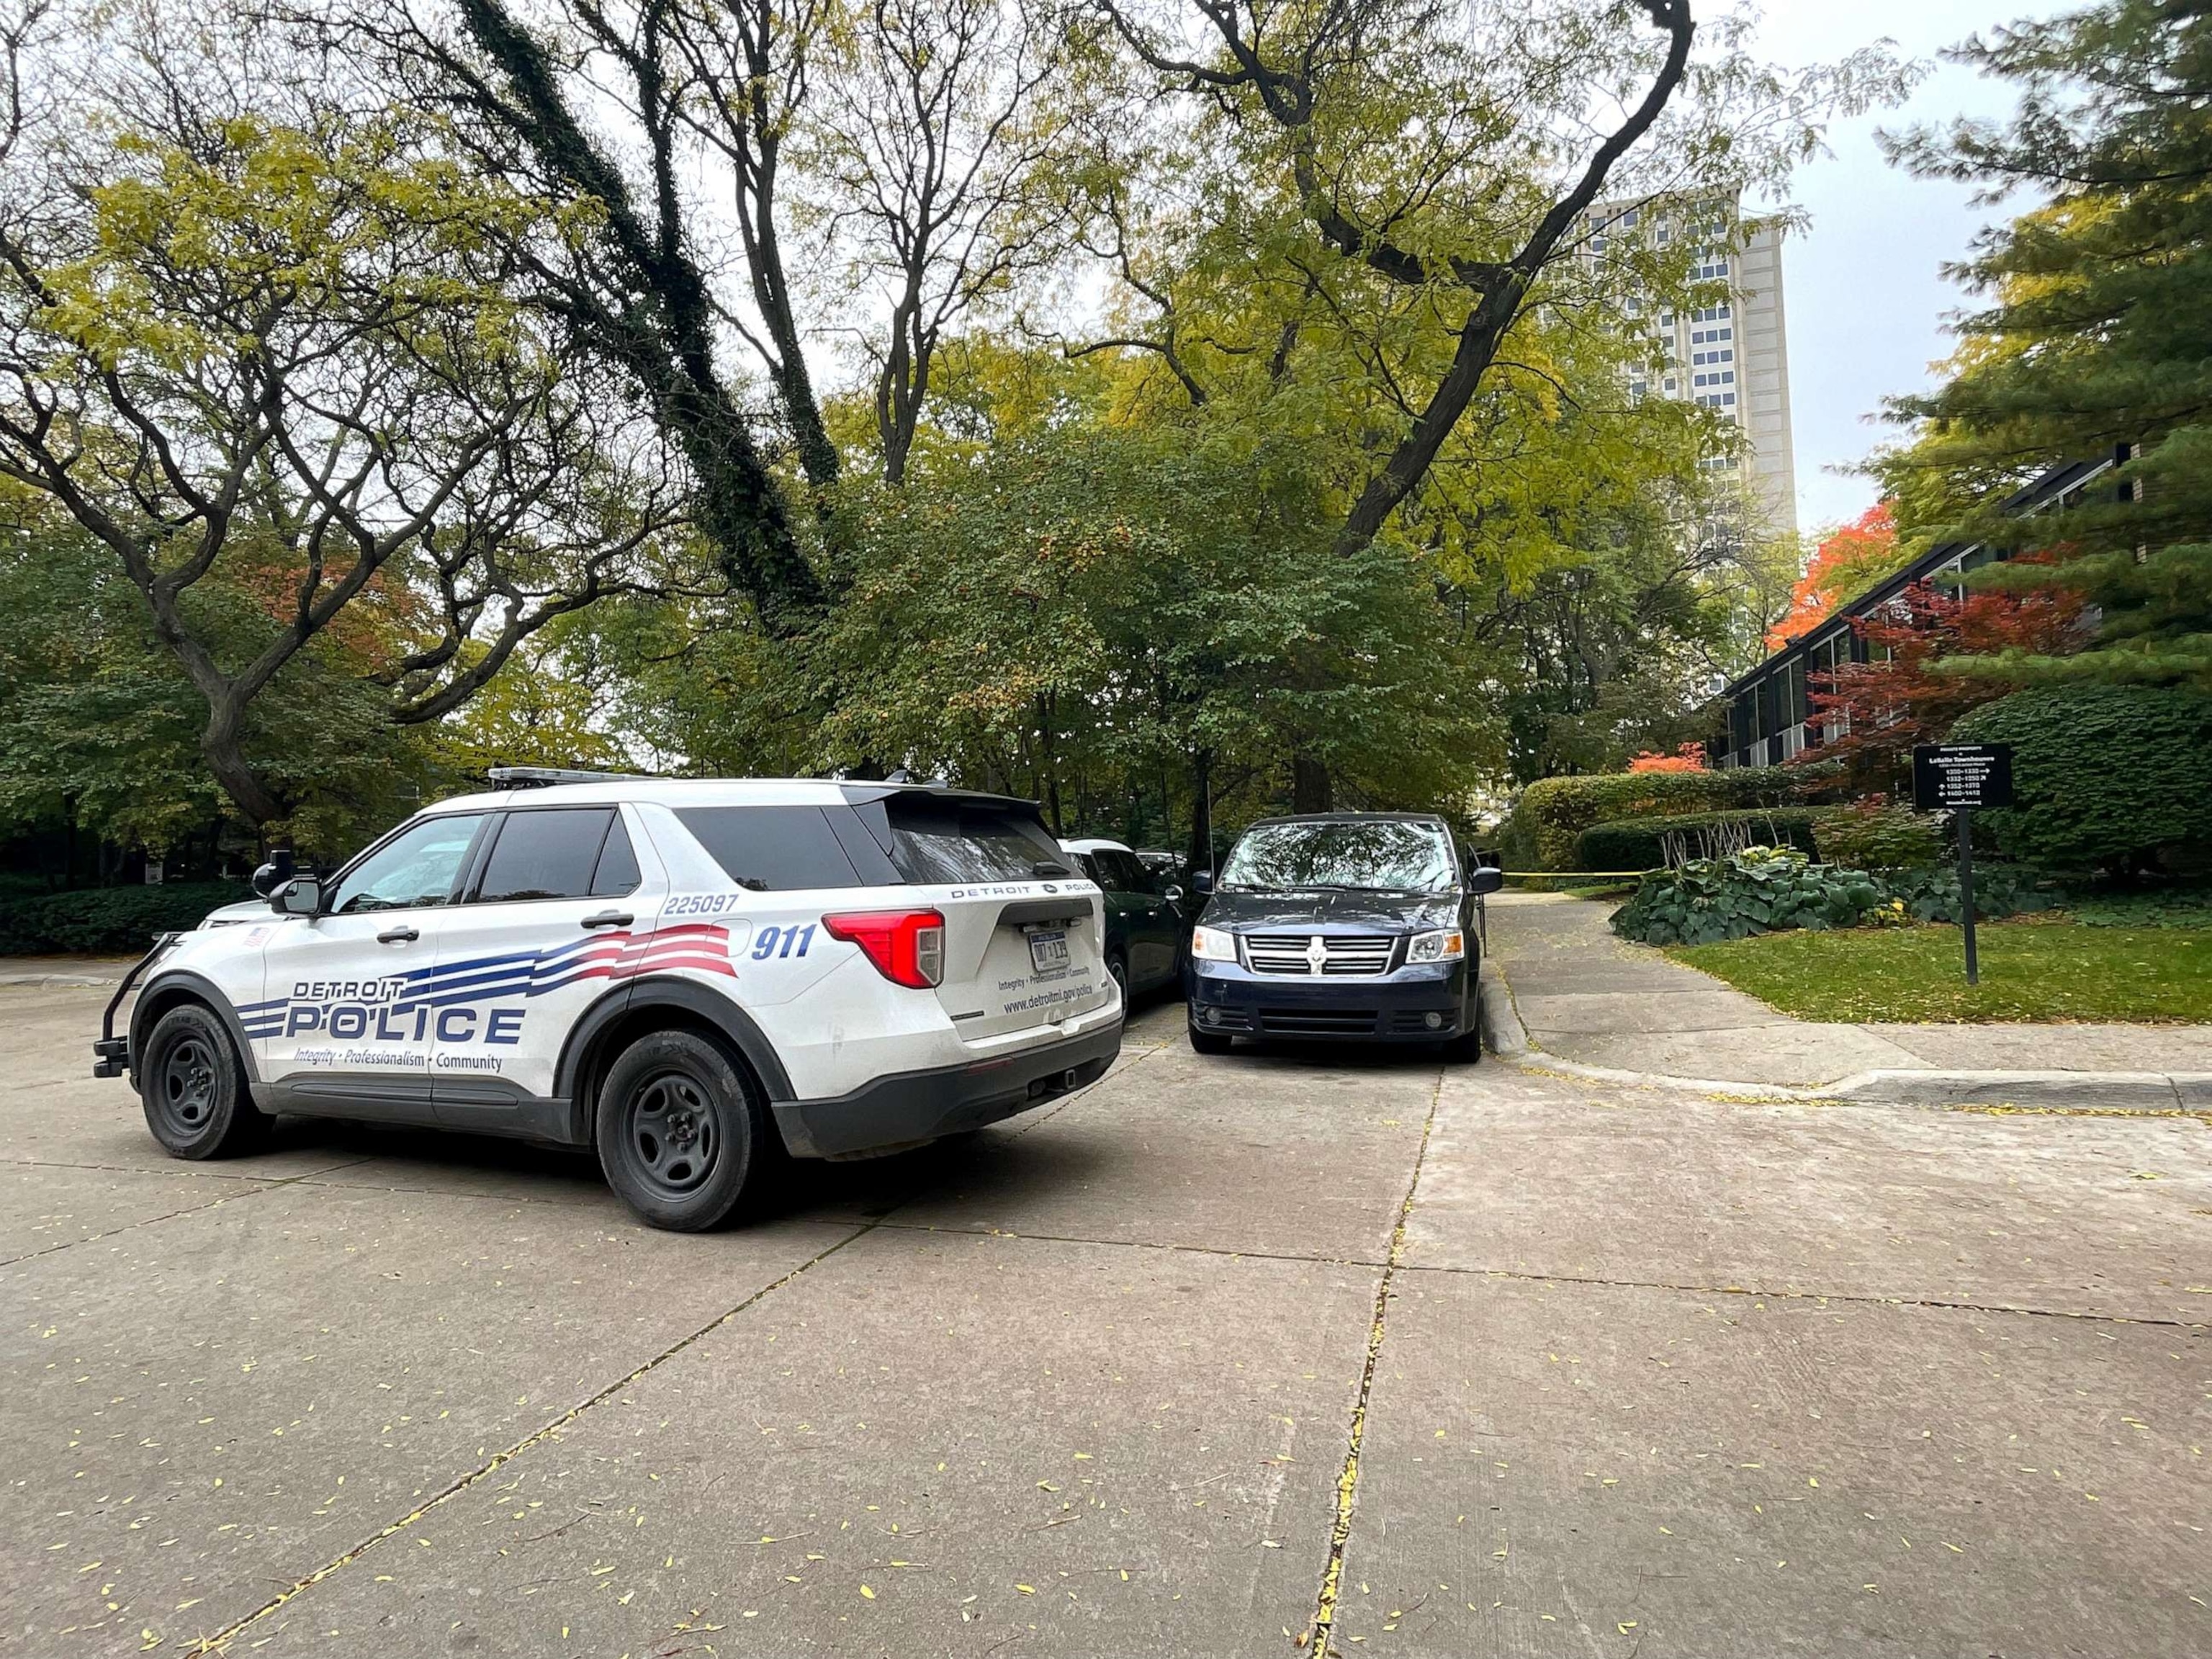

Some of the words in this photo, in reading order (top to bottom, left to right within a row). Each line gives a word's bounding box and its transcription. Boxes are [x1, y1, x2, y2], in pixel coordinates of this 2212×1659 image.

[664, 894, 739, 914] 225097
[951, 886, 1030, 899] DETROIT
[751, 924, 817, 960] 911
[293, 981, 403, 997] DETROIT
[999, 978, 1025, 991] Integrity
[1030, 970, 1066, 984] Professionalism
[1004, 984, 1092, 1014] www.detroitmi.gov/police
[286, 1007, 526, 1044] POLICE
[294, 1048, 336, 1066] Integrity
[344, 1049, 424, 1066] Professionalism
[436, 1053, 502, 1073] Community
